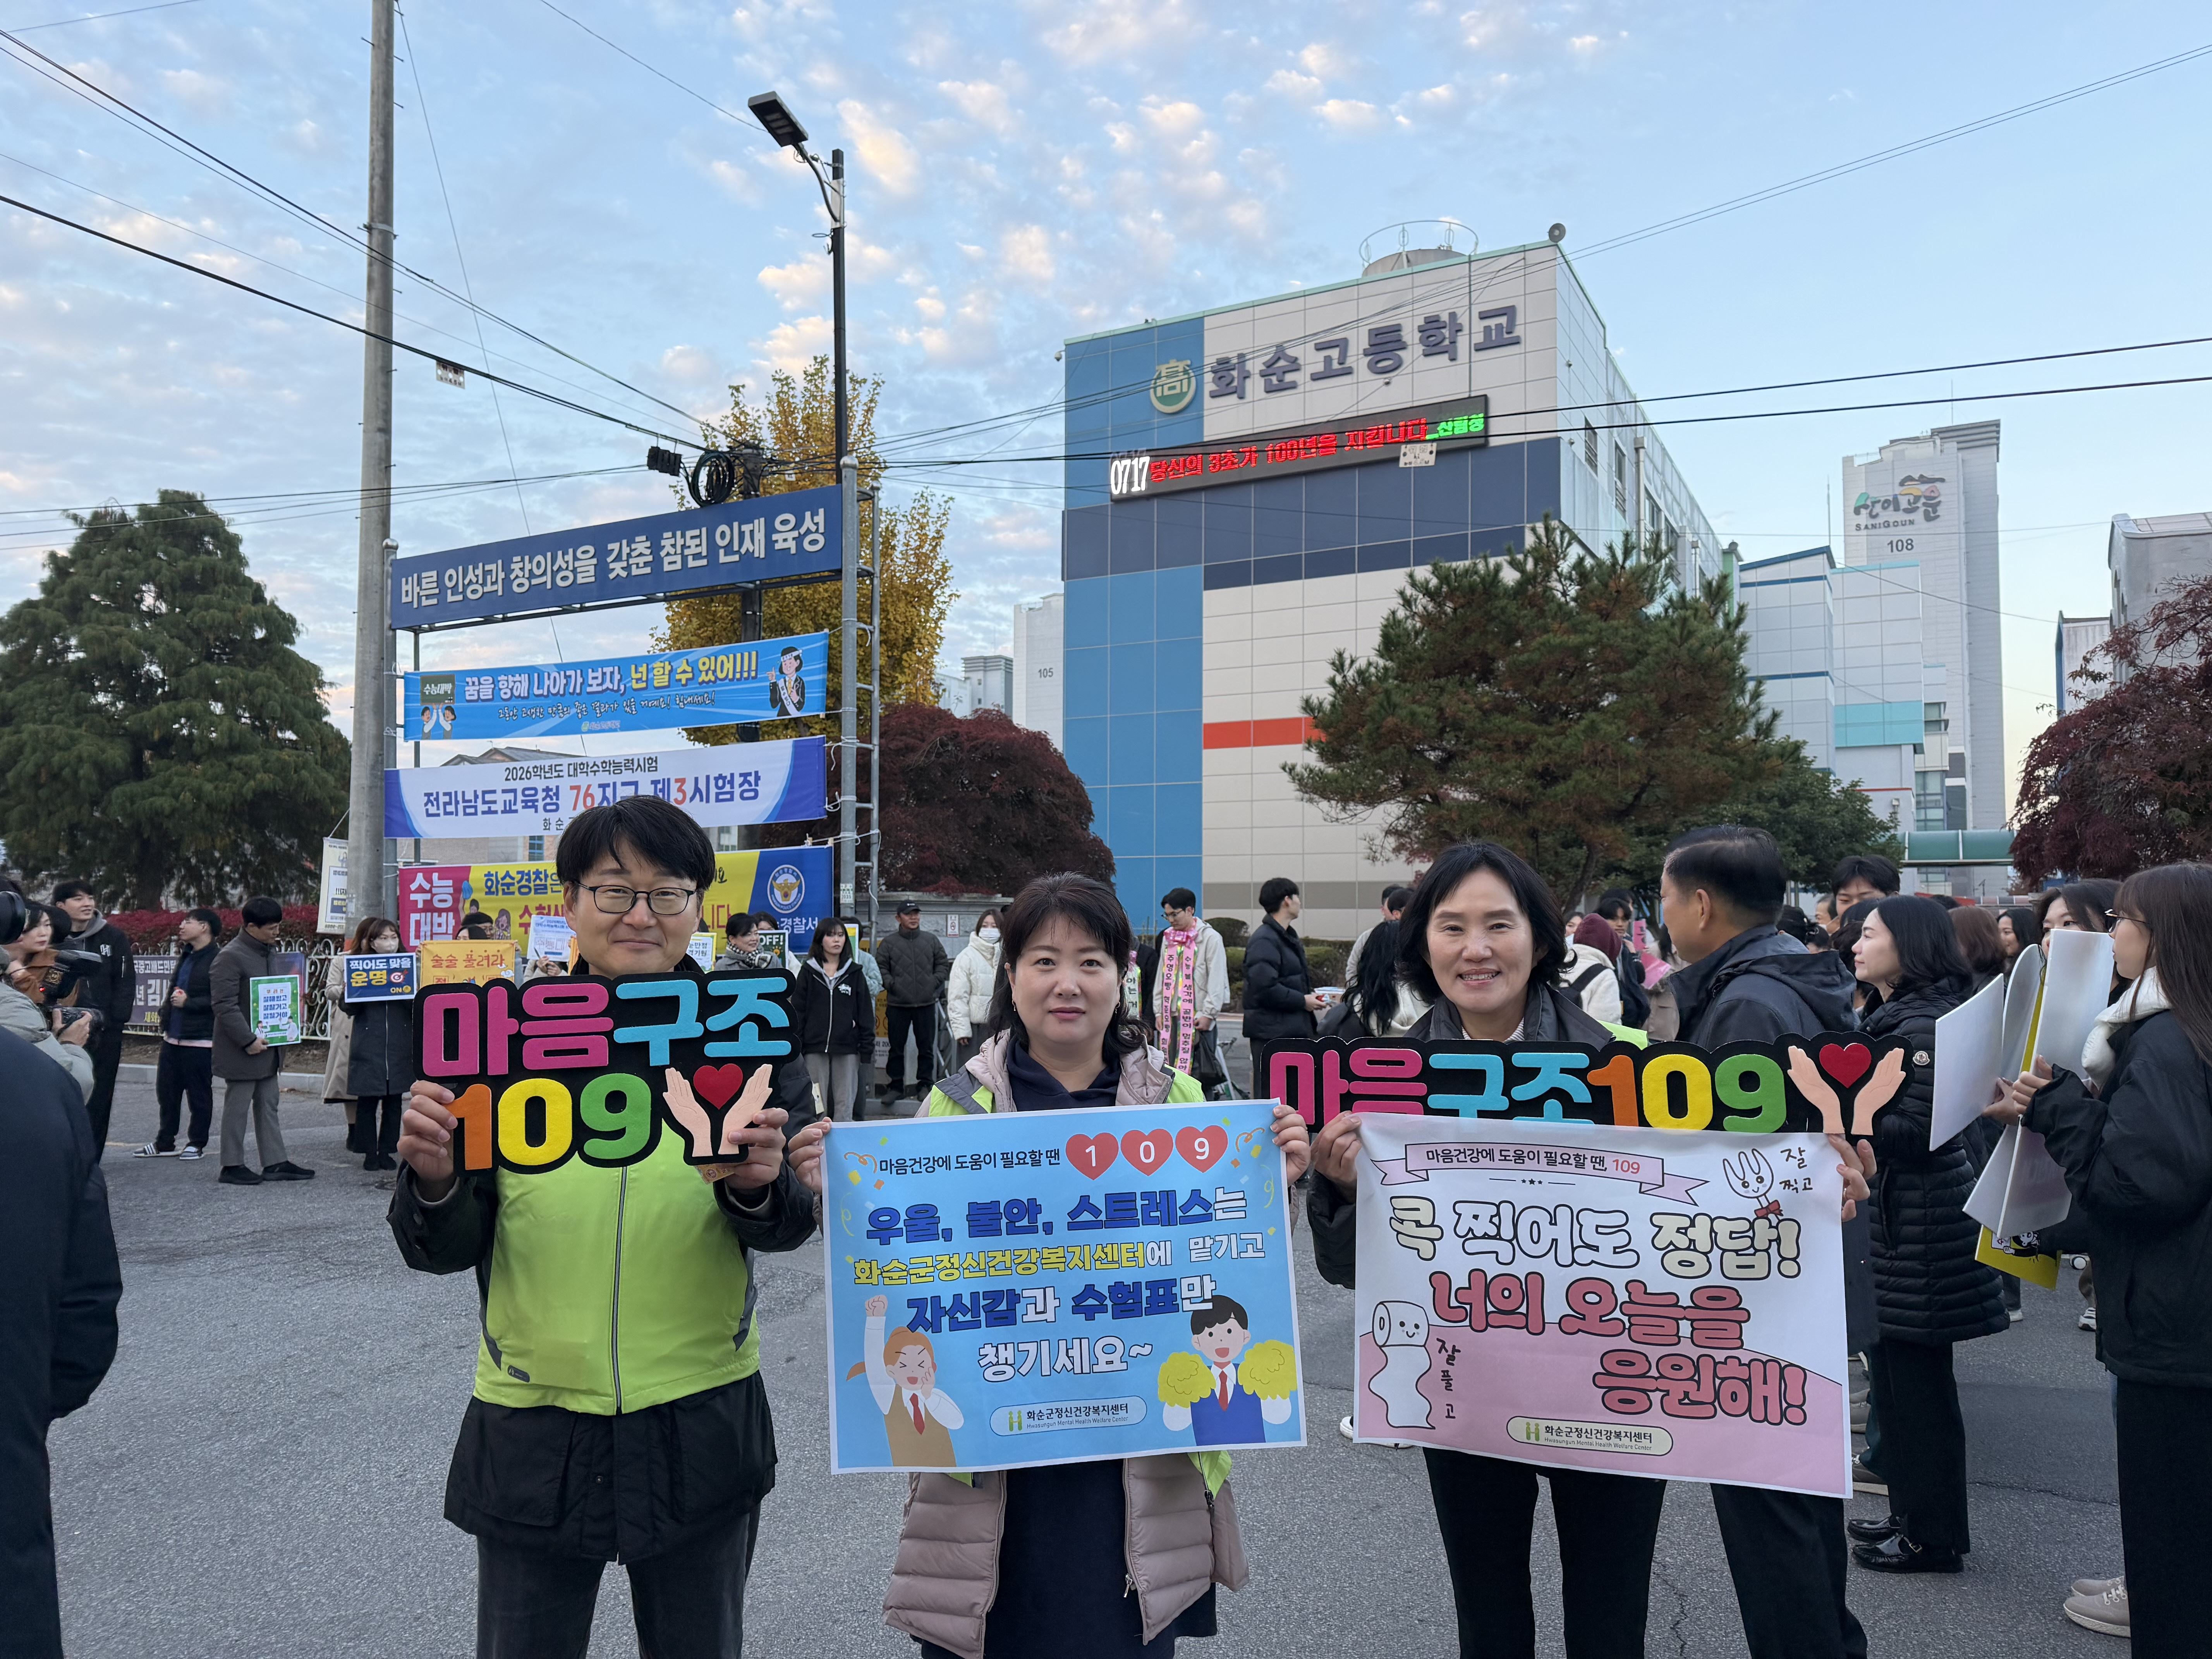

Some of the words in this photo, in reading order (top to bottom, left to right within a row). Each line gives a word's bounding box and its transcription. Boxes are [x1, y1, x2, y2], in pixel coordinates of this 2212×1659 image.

[1209, 305, 1521, 399] 화순고등학교
[1150, 454, 1203, 483] 당신의
[1266, 433, 1337, 464] 100년을
[1110, 456, 1150, 495] 0717
[1855, 519, 1915, 531] SANIGOUN
[401, 570, 439, 608] 바른
[444, 559, 505, 603] 인성과
[510, 545, 598, 593] 창의성을
[606, 535, 653, 580] 갖춘
[659, 527, 708, 572] 참된
[715, 517, 765, 564] 인재
[772, 508, 825, 555] 육성
[1887, 539, 1914, 553] 108
[465, 676, 495, 701] 꿈을
[498, 673, 529, 699] 향해
[533, 668, 583, 696] 나아가
[586, 666, 626, 694] 보자,
[631, 663, 647, 689] 넌
[653, 661, 671, 687] 할
[675, 659, 693, 685] 수
[698, 651, 757, 683] 있어!!!
[1038, 668, 1053, 678] 105
[423, 682, 452, 695] 수능대박
[499, 707, 518, 720] 그동안
[592, 701, 619, 717] 결과가
[623, 697, 637, 714] 있을
[505, 763, 564, 781] 2026학년도
[568, 756, 658, 778] 대학수학능력시험
[424, 785, 560, 817] 전라남도교육청
[651, 770, 761, 805] 제3시험장
[410, 872, 453, 908] 수능
[409, 912, 455, 946] 대박
[777, 917, 818, 934] 경찰서
[350, 960, 387, 970] 찍어도
[389, 957, 411, 969] 맞을
[431, 954, 458, 968] 술술
[464, 952, 506, 968] 풀려라
[350, 970, 387, 987] 운명
[423, 976, 791, 1077] 마음구조
[441, 1073, 652, 1171] 109
[879, 1154, 951, 1175] 마음건강에
[954, 1152, 997, 1170] 도움이
[1000, 1149, 1043, 1169] 필요할
[1046, 1148, 1060, 1166] 땐
[1426, 1148, 1494, 1163] 마음건강에
[1498, 1149, 1540, 1164] 도움이
[1544, 1151, 1588, 1169] 필요할
[1590, 1156, 1607, 1171] 땐,
[1612, 1159, 1640, 1174] 109
[1780, 1147, 1806, 1169] 잘
[1779, 1178, 1813, 1194] 찍고
[866, 1203, 953, 1245] 우울,
[967, 1197, 1053, 1238] 불안,
[1067, 1187, 1246, 1231] 스트레스는
[1389, 1195, 1444, 1261] 콕
[1453, 1200, 1640, 1269] 찍어도
[1650, 1212, 1801, 1280] 정답!
[854, 1241, 1172, 1286] 화순군정신건강복지센터에
[1189, 1232, 1265, 1262] 맡기고
[906, 1286, 1060, 1334] 자신감과
[1072, 1274, 1216, 1321] 수험표만
[1429, 1268, 1545, 1336] 너의
[1558, 1277, 1751, 1350] 오늘을
[978, 1336, 1153, 1382] 챙기세요~
[1436, 1338, 1461, 1366] 잘
[1592, 1349, 1807, 1425] 응원해!
[1027, 1403, 1128, 1421] 화순군정신건강복지센터
[1544, 1425, 1652, 1443] 화순군정신건강복지센터
[1544, 1437, 1575, 1445] Hwasungun
